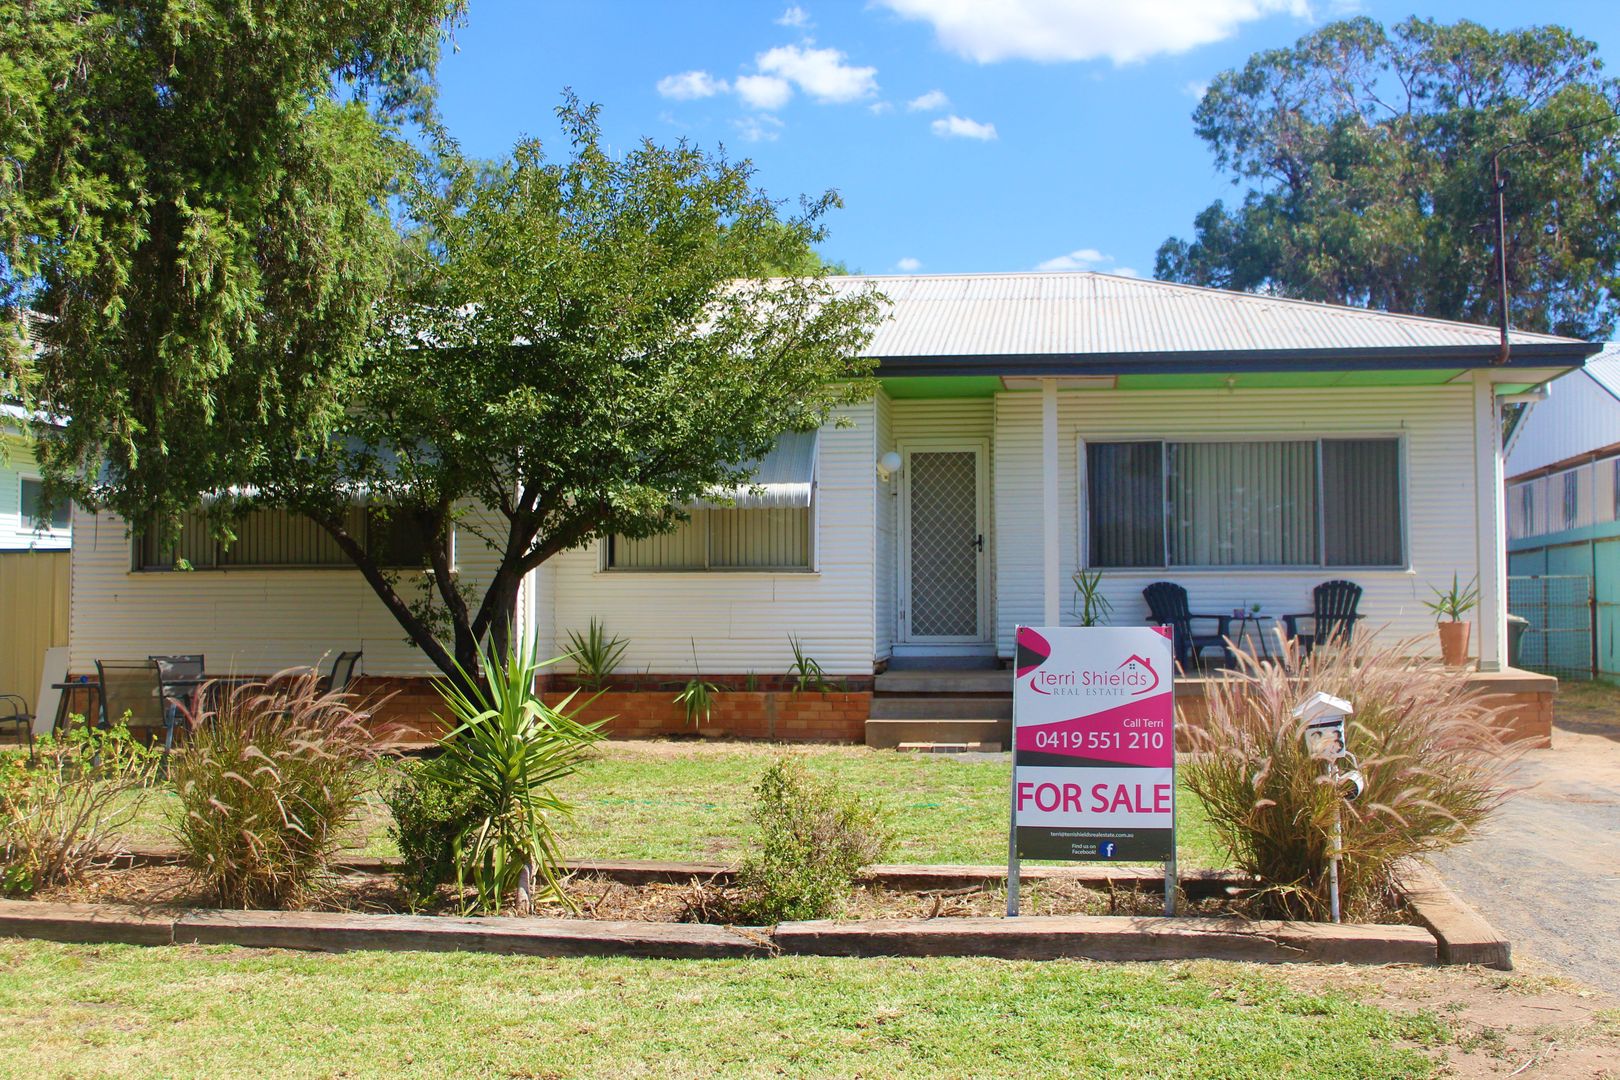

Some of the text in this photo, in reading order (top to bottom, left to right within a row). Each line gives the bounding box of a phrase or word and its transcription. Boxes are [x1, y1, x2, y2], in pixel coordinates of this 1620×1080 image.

[1039, 671, 1147, 686] Terri Shields
[1053, 688, 1125, 696] REAL ESTATE
[1123, 718, 1164, 728] Call Terri
[1035, 731, 1164, 749] 0419 551 210
[1017, 782, 1171, 813] FOR SALE
